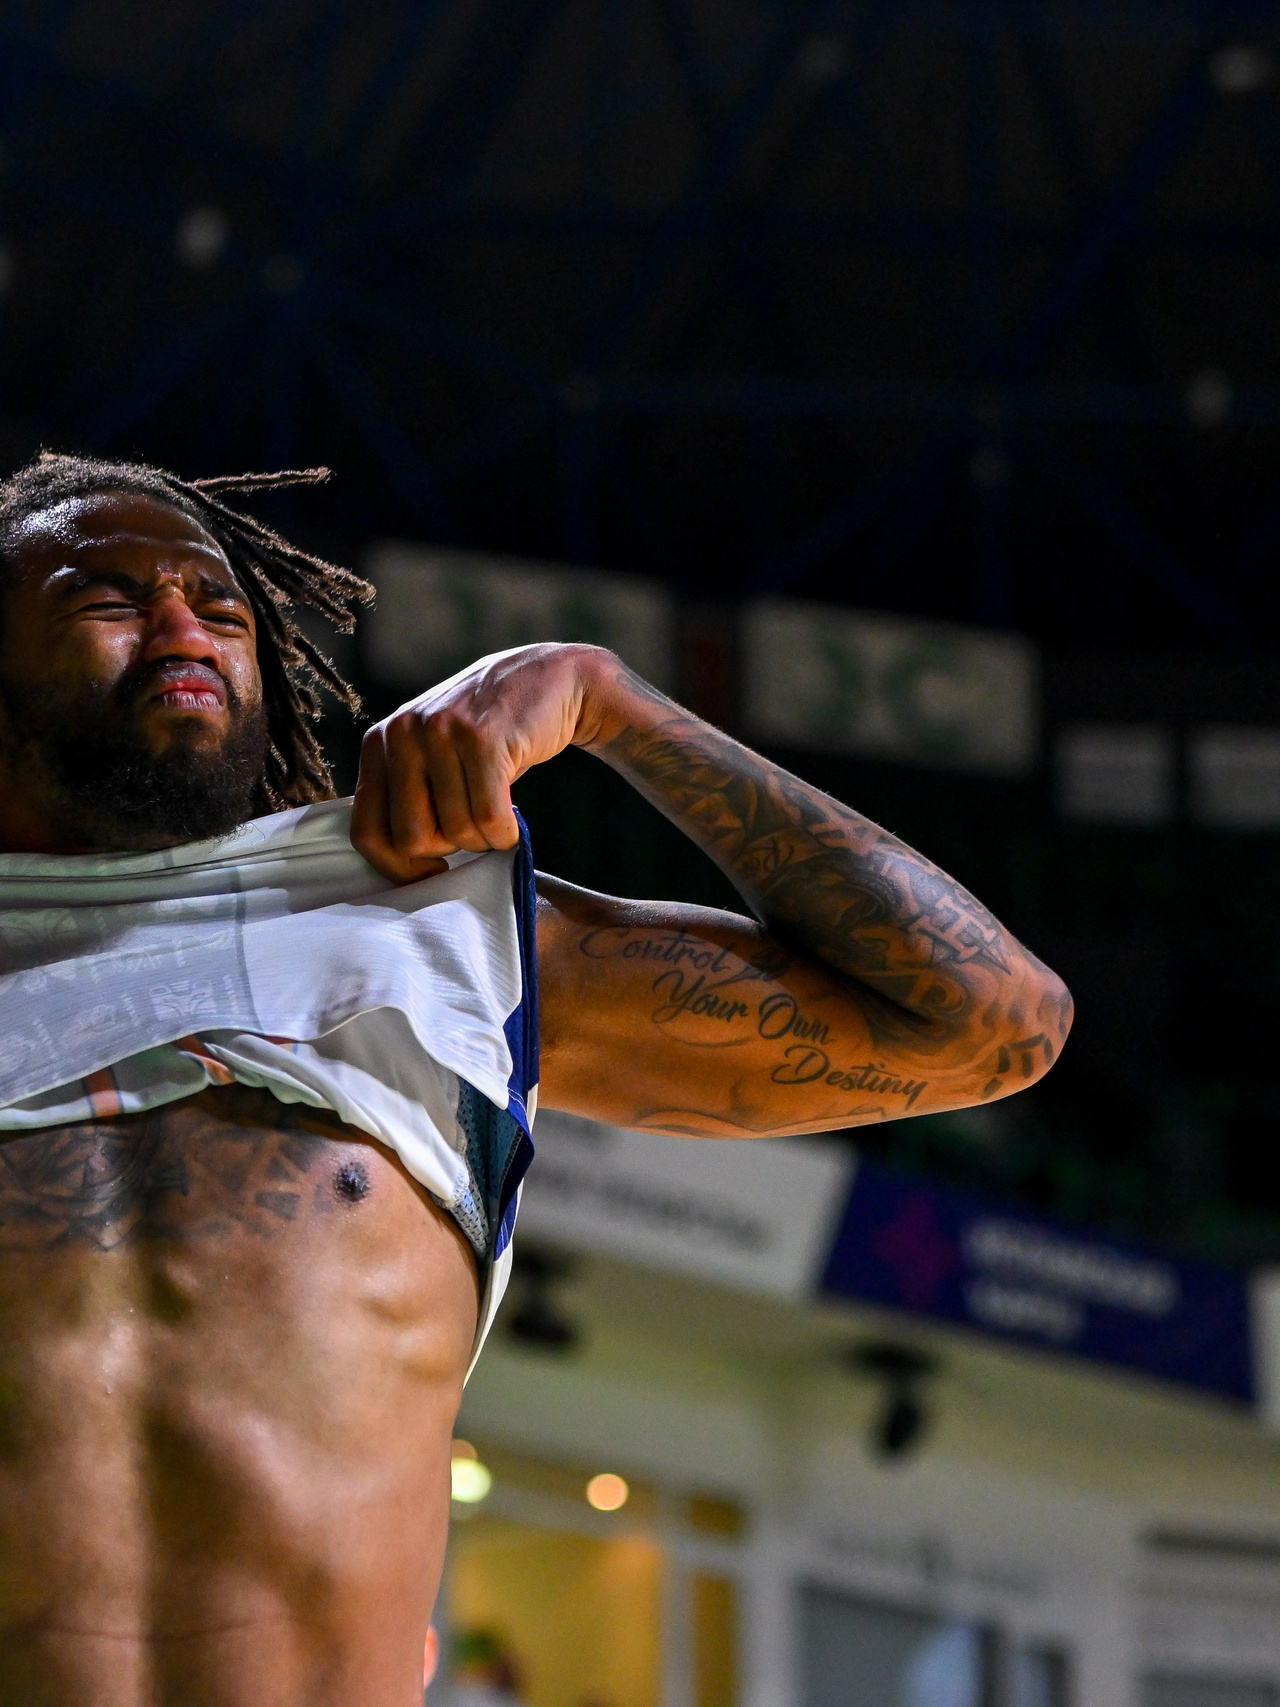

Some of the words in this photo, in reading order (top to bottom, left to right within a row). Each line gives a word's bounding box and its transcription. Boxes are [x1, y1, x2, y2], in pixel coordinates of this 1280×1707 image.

[651, 969, 749, 1024] Your
[758, 993, 837, 1045] Own
[771, 1044, 928, 1110] Destiny
